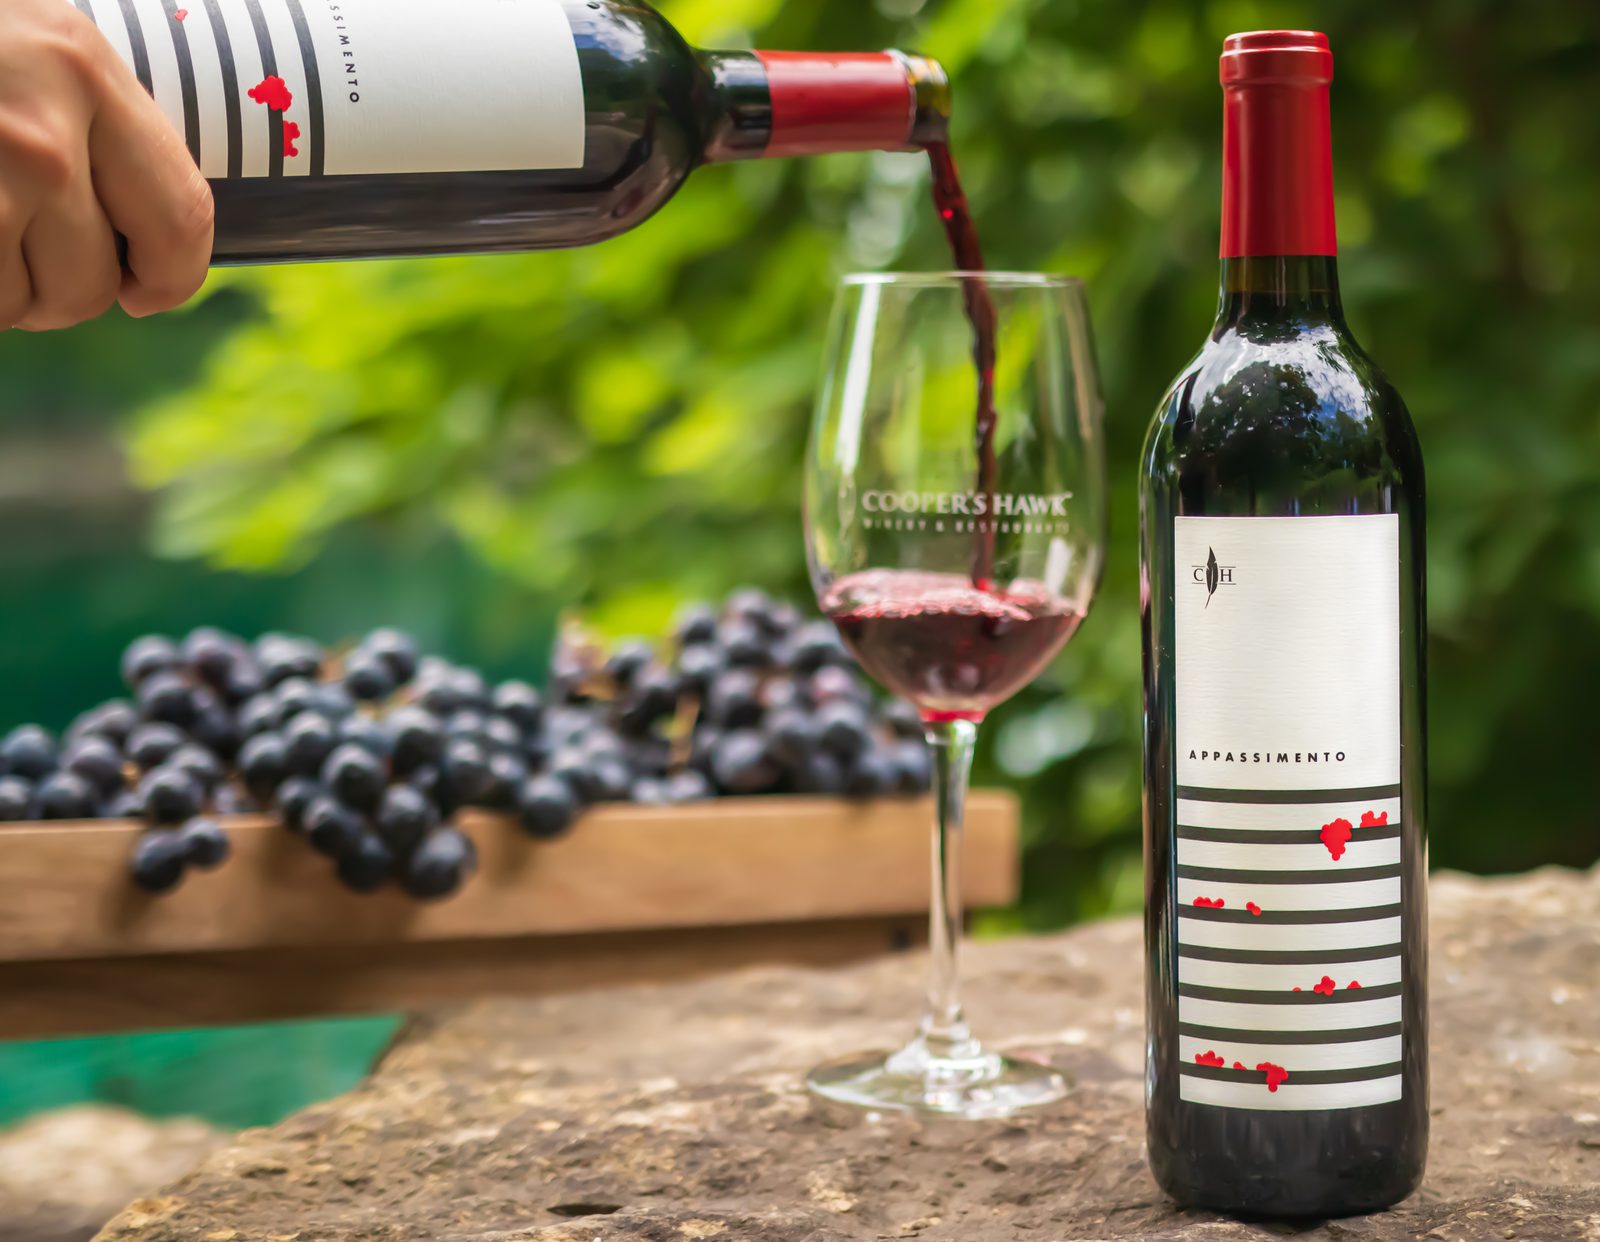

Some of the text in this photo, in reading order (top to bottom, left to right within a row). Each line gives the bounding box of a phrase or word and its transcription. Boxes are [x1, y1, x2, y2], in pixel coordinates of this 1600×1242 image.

[326, 0, 360, 103] SSIMENTO
[862, 489, 988, 515] COOPER'S
[1188, 749, 1346, 763] APPASSIMENTO
